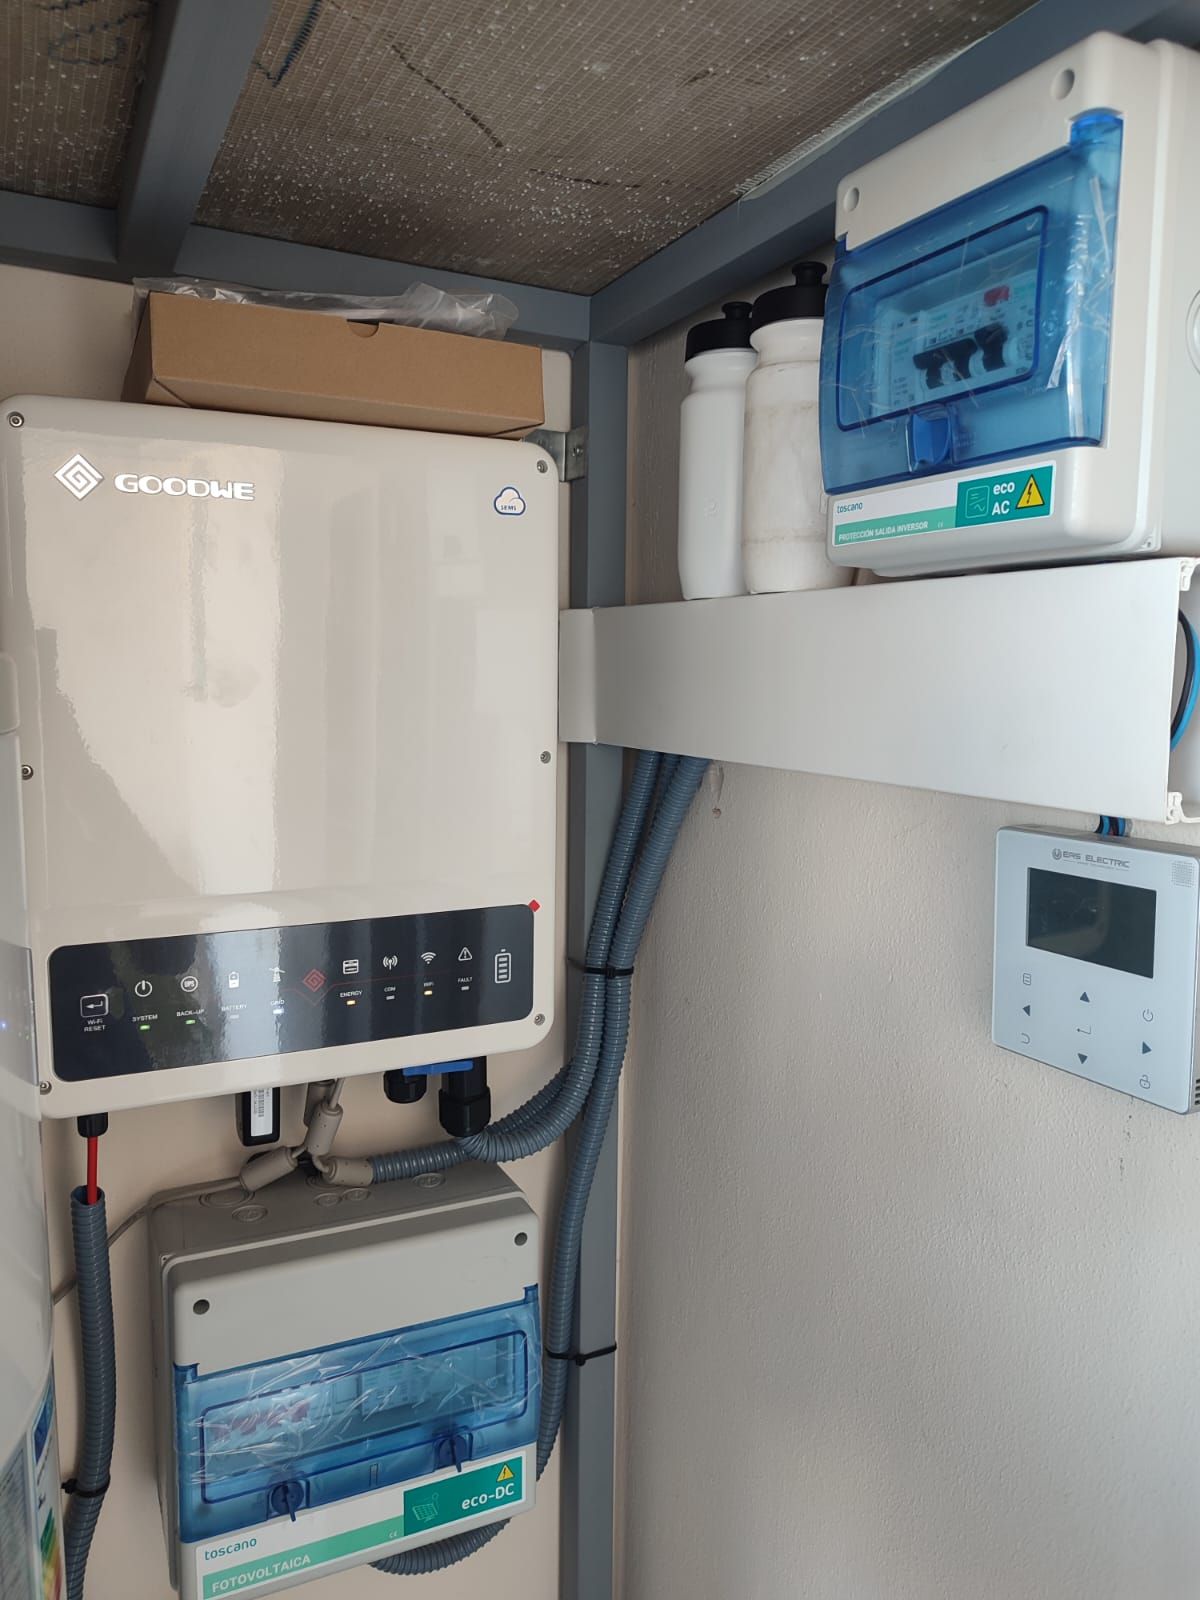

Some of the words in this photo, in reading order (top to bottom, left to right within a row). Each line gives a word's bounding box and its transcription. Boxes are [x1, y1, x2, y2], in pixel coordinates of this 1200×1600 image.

[114, 473, 255, 501] GOODWE
[992, 481, 1016, 496] eco
[836, 501, 864, 514] toscano
[991, 500, 1011, 516] AC
[874, 525, 896, 538] SALIDA
[896, 520, 929, 534] INVERSOR
[340, 990, 363, 998] ENERGY
[131, 1013, 159, 1023] SYSTEM
[176, 1008, 205, 1017] BACK-UP
[83, 1024, 107, 1032] RESET
[461, 1482, 516, 1510] eco-DC
[204, 1537, 258, 1561] toscano
[211, 1554, 312, 1593] FOTOVOLTAICA
